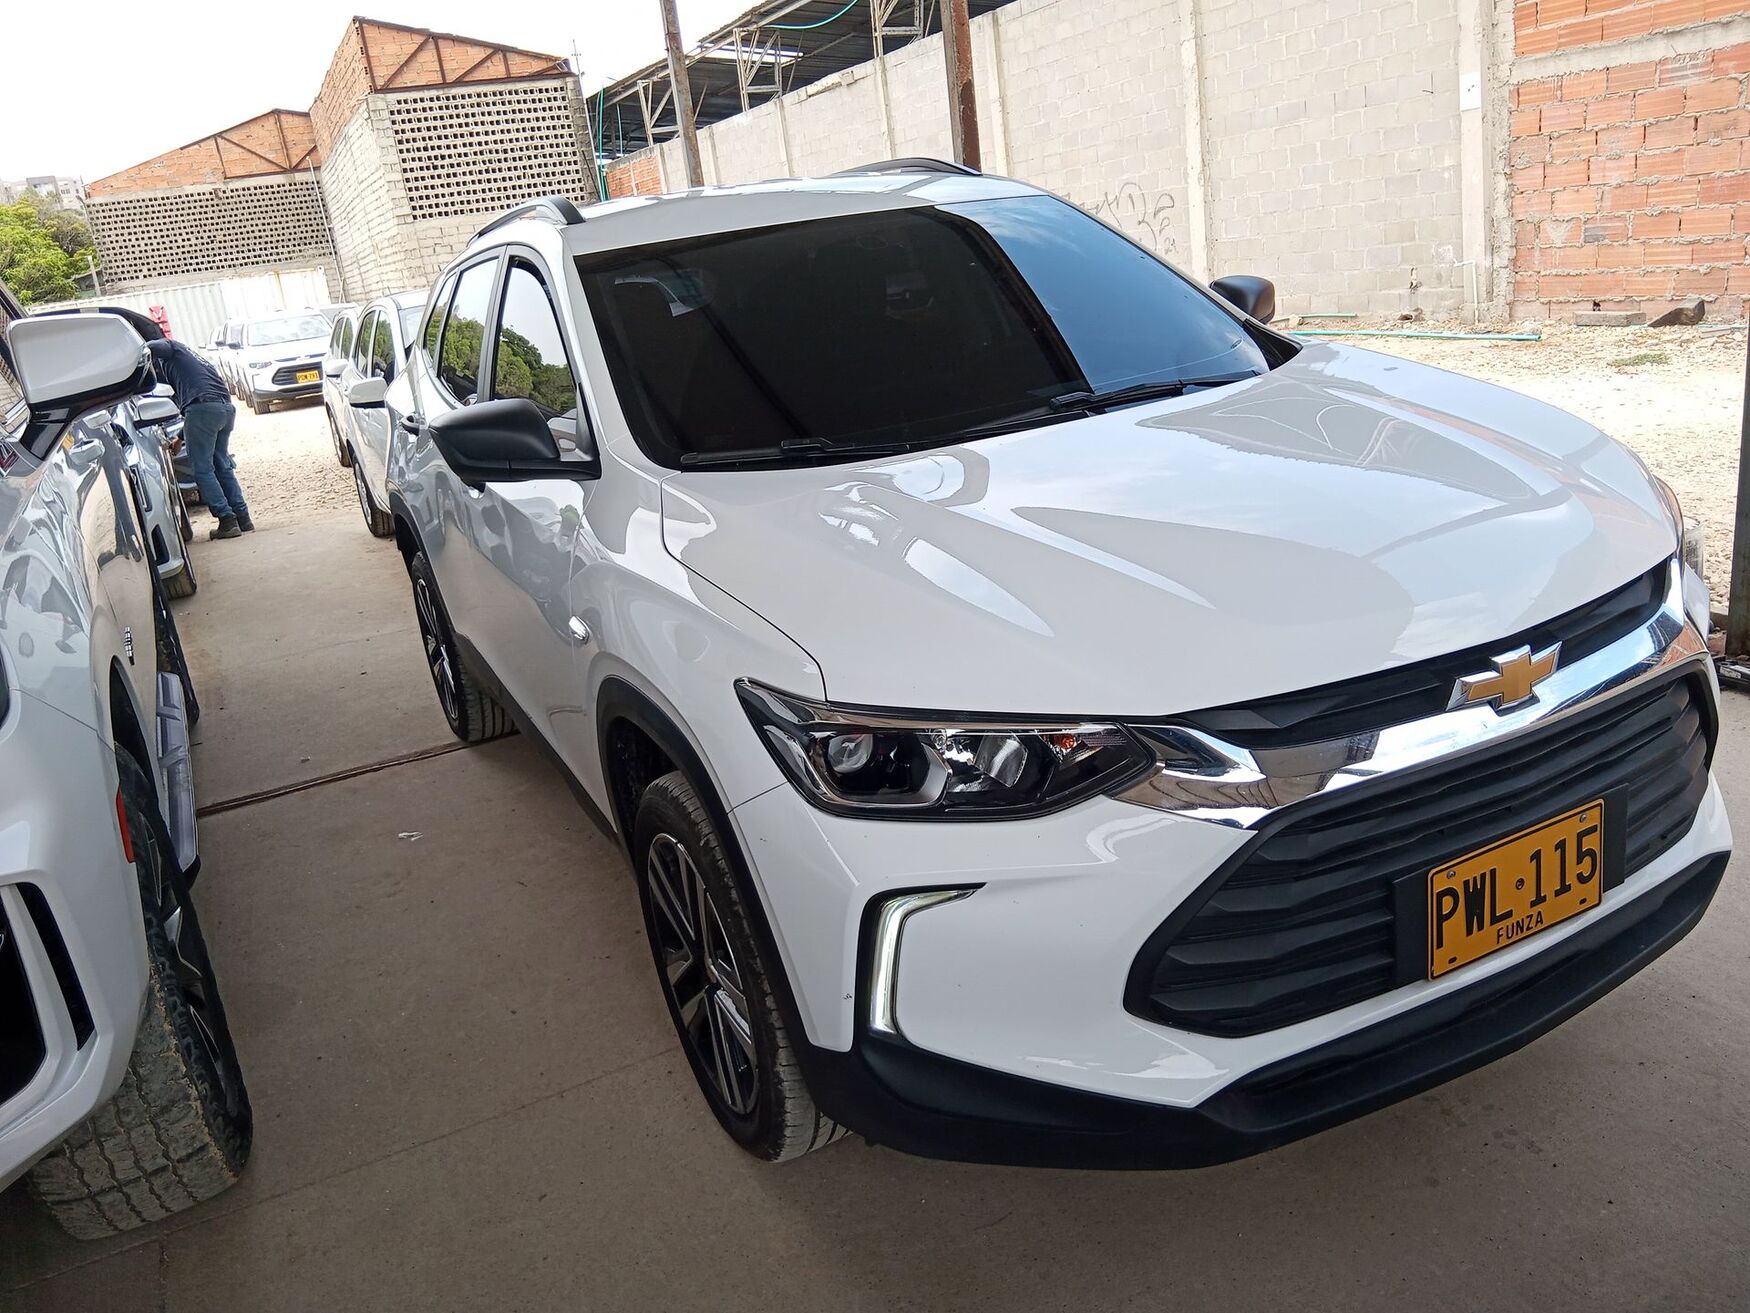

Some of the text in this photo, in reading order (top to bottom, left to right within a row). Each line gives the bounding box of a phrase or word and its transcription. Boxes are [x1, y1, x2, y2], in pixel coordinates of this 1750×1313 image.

[1436, 824, 1598, 949] PWL 115
[1496, 910, 1544, 945] FUNZA
